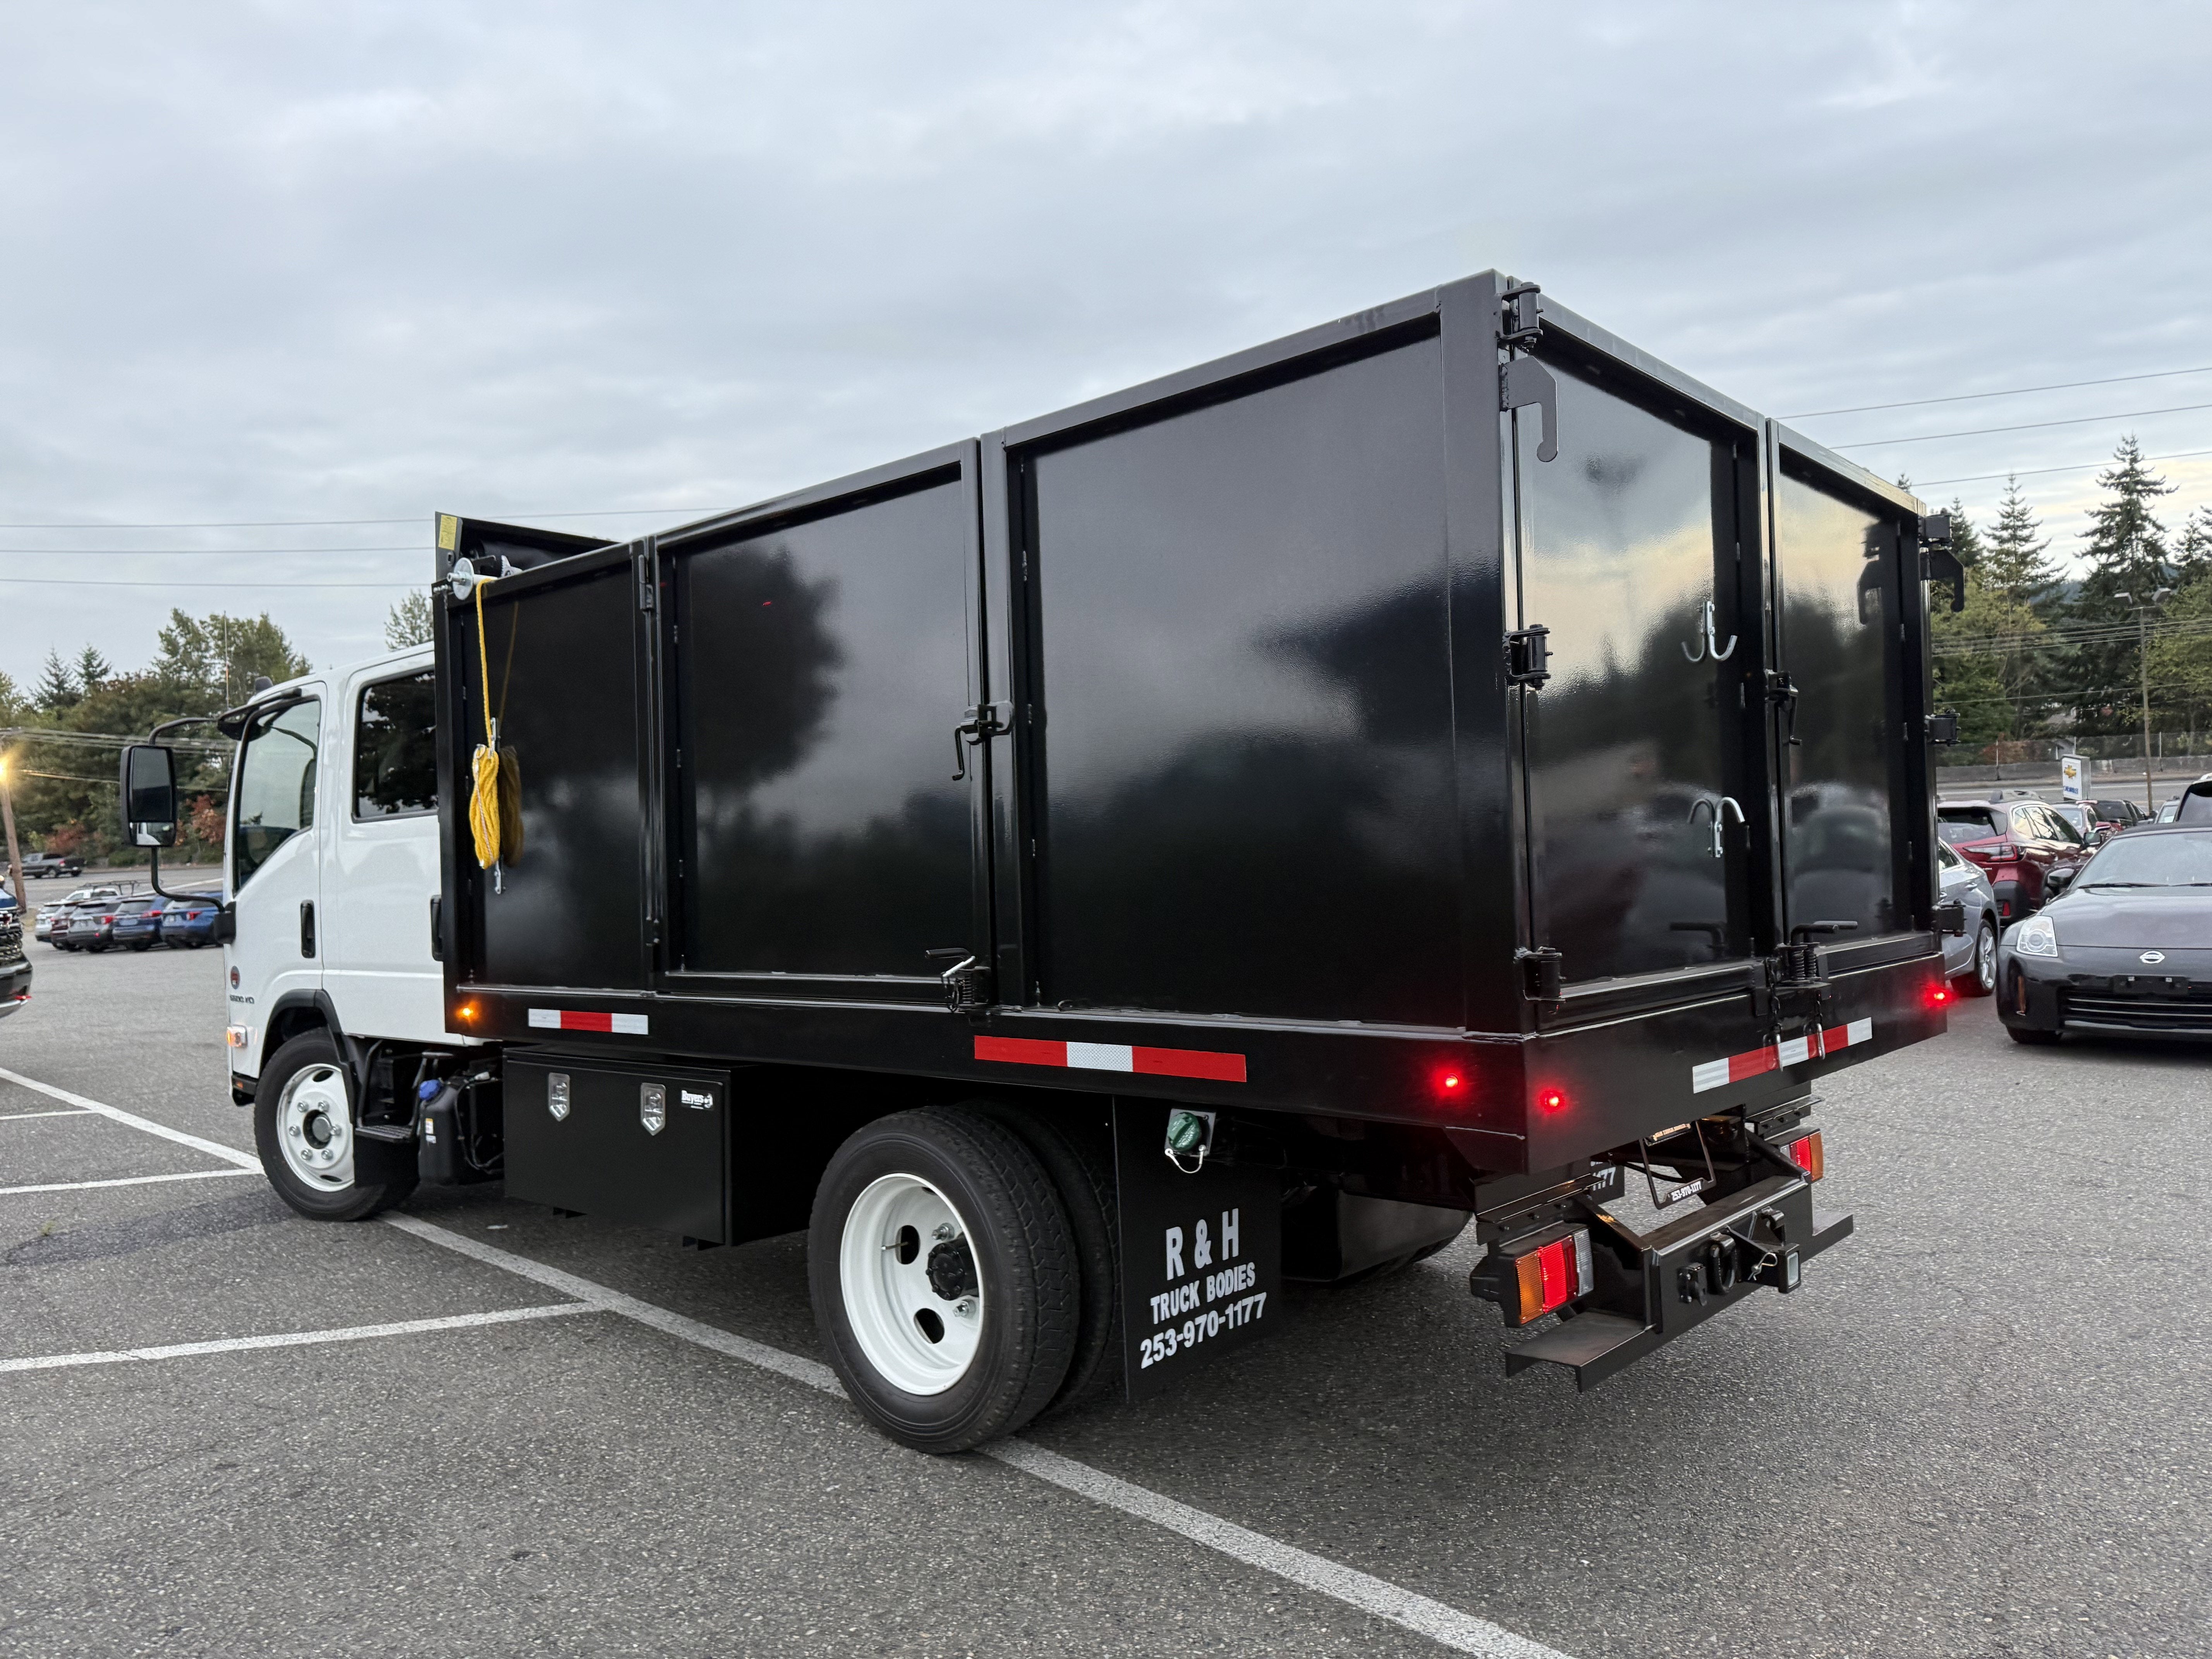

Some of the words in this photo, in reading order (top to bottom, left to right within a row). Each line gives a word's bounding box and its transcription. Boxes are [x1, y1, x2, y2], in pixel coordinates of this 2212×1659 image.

[1671, 1181, 1702, 1201] 253-970-1177
[1166, 1226, 1185, 1280] R
[1194, 1219, 1212, 1269] &
[1222, 1208, 1239, 1261] H
[1150, 1280, 1200, 1324] TRUCK
[1207, 1262, 1256, 1303] BODIES
[1140, 1292, 1267, 1369] 253-970-1177
